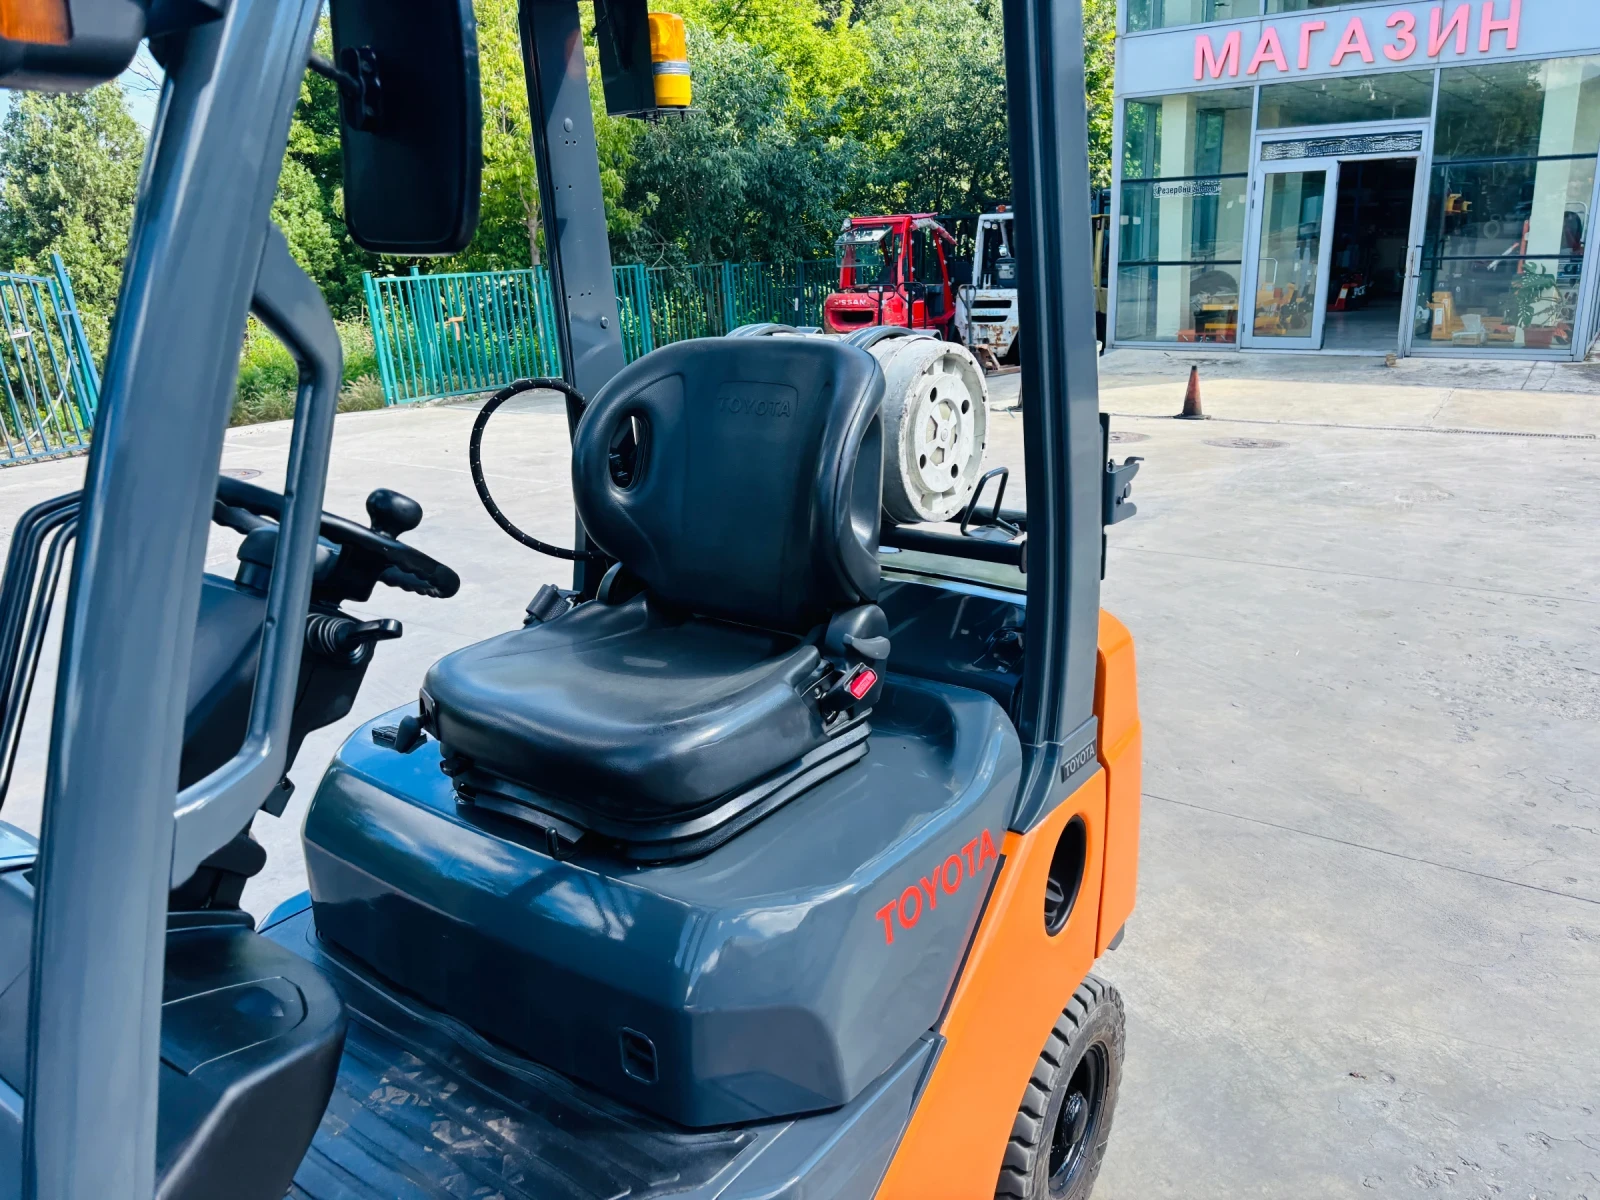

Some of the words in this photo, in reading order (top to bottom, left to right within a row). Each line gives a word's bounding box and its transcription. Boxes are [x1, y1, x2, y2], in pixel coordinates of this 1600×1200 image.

[1193, 0, 1523, 80] МАГАЗИН
[718, 397, 791, 418] TOYOTA
[1064, 743, 1096, 777] TOYOTA
[875, 828, 998, 945] TOYOTA
